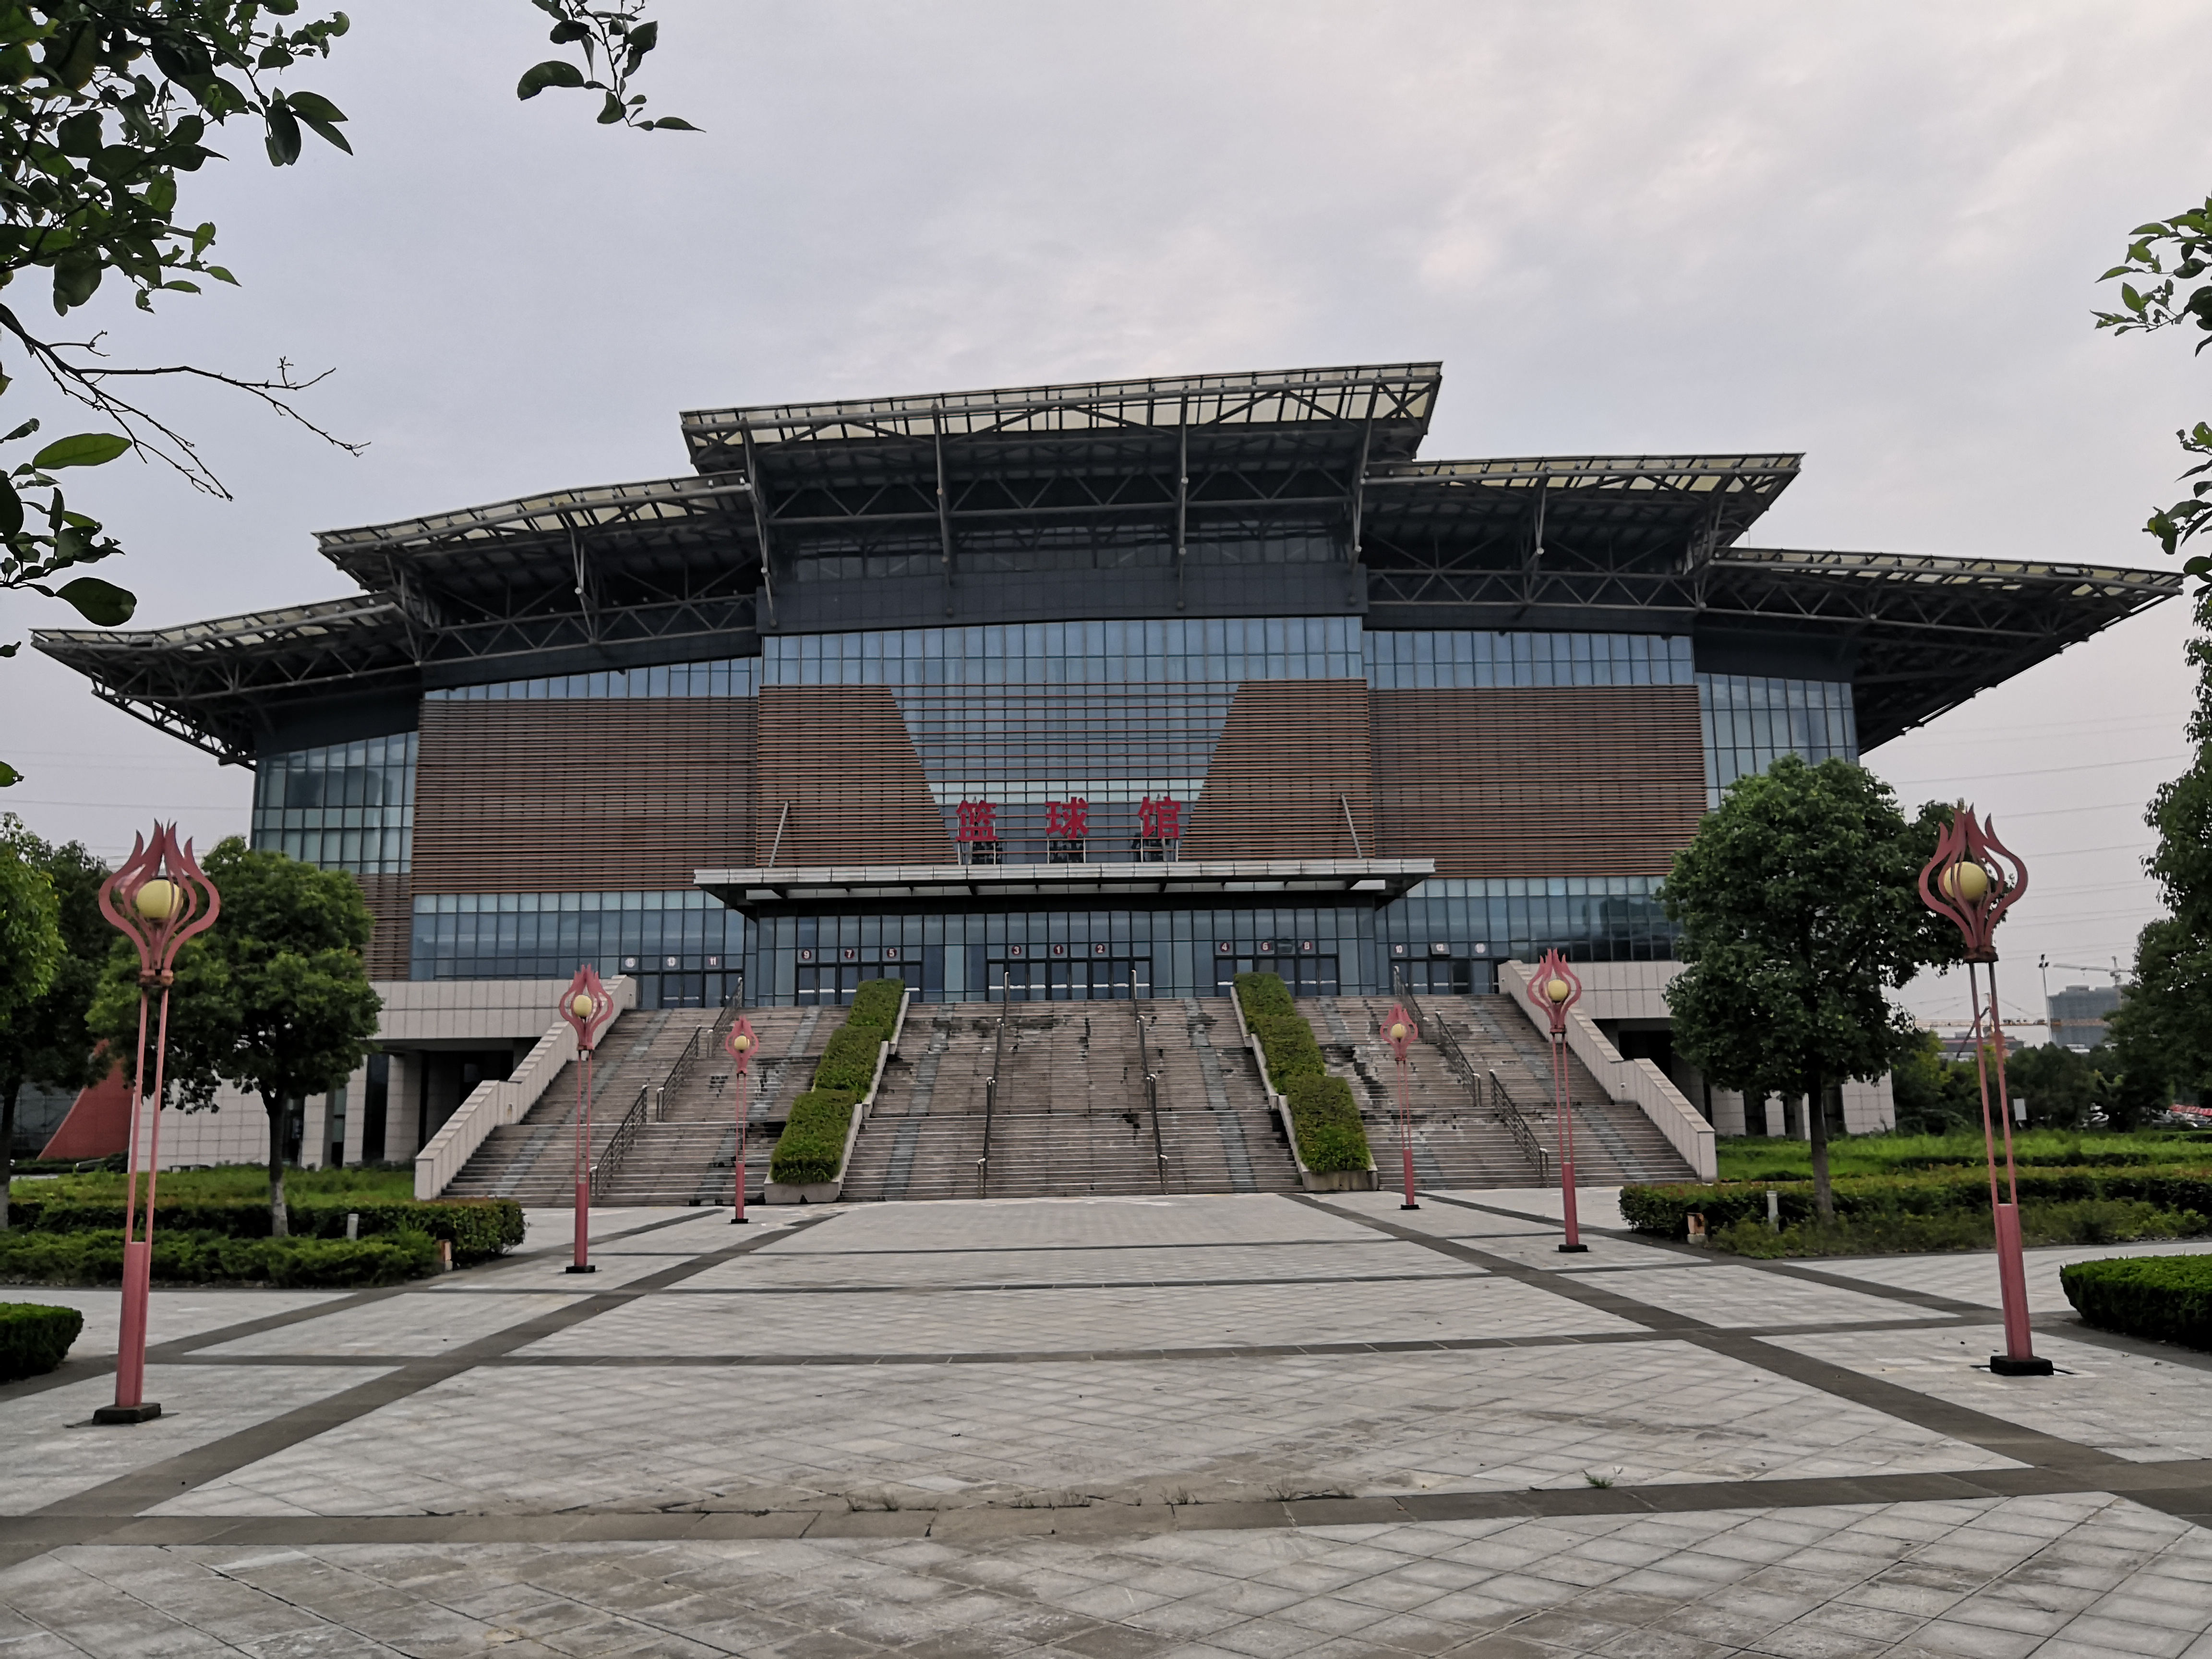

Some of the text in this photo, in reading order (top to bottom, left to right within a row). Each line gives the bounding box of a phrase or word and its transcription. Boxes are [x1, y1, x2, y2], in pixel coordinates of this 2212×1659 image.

[955, 796, 1180, 841] 篮球馆
[1013, 946, 1020, 955] 3
[1056, 945, 1061, 954] 1
[1097, 944, 1103, 953] 2
[1221, 942, 1228, 951] 4
[1262, 942, 1269, 951] 6
[804, 950, 810, 959] 9
[846, 950, 853, 958] 7
[889, 948, 895, 957] 5
[709, 956, 717, 965] 11
